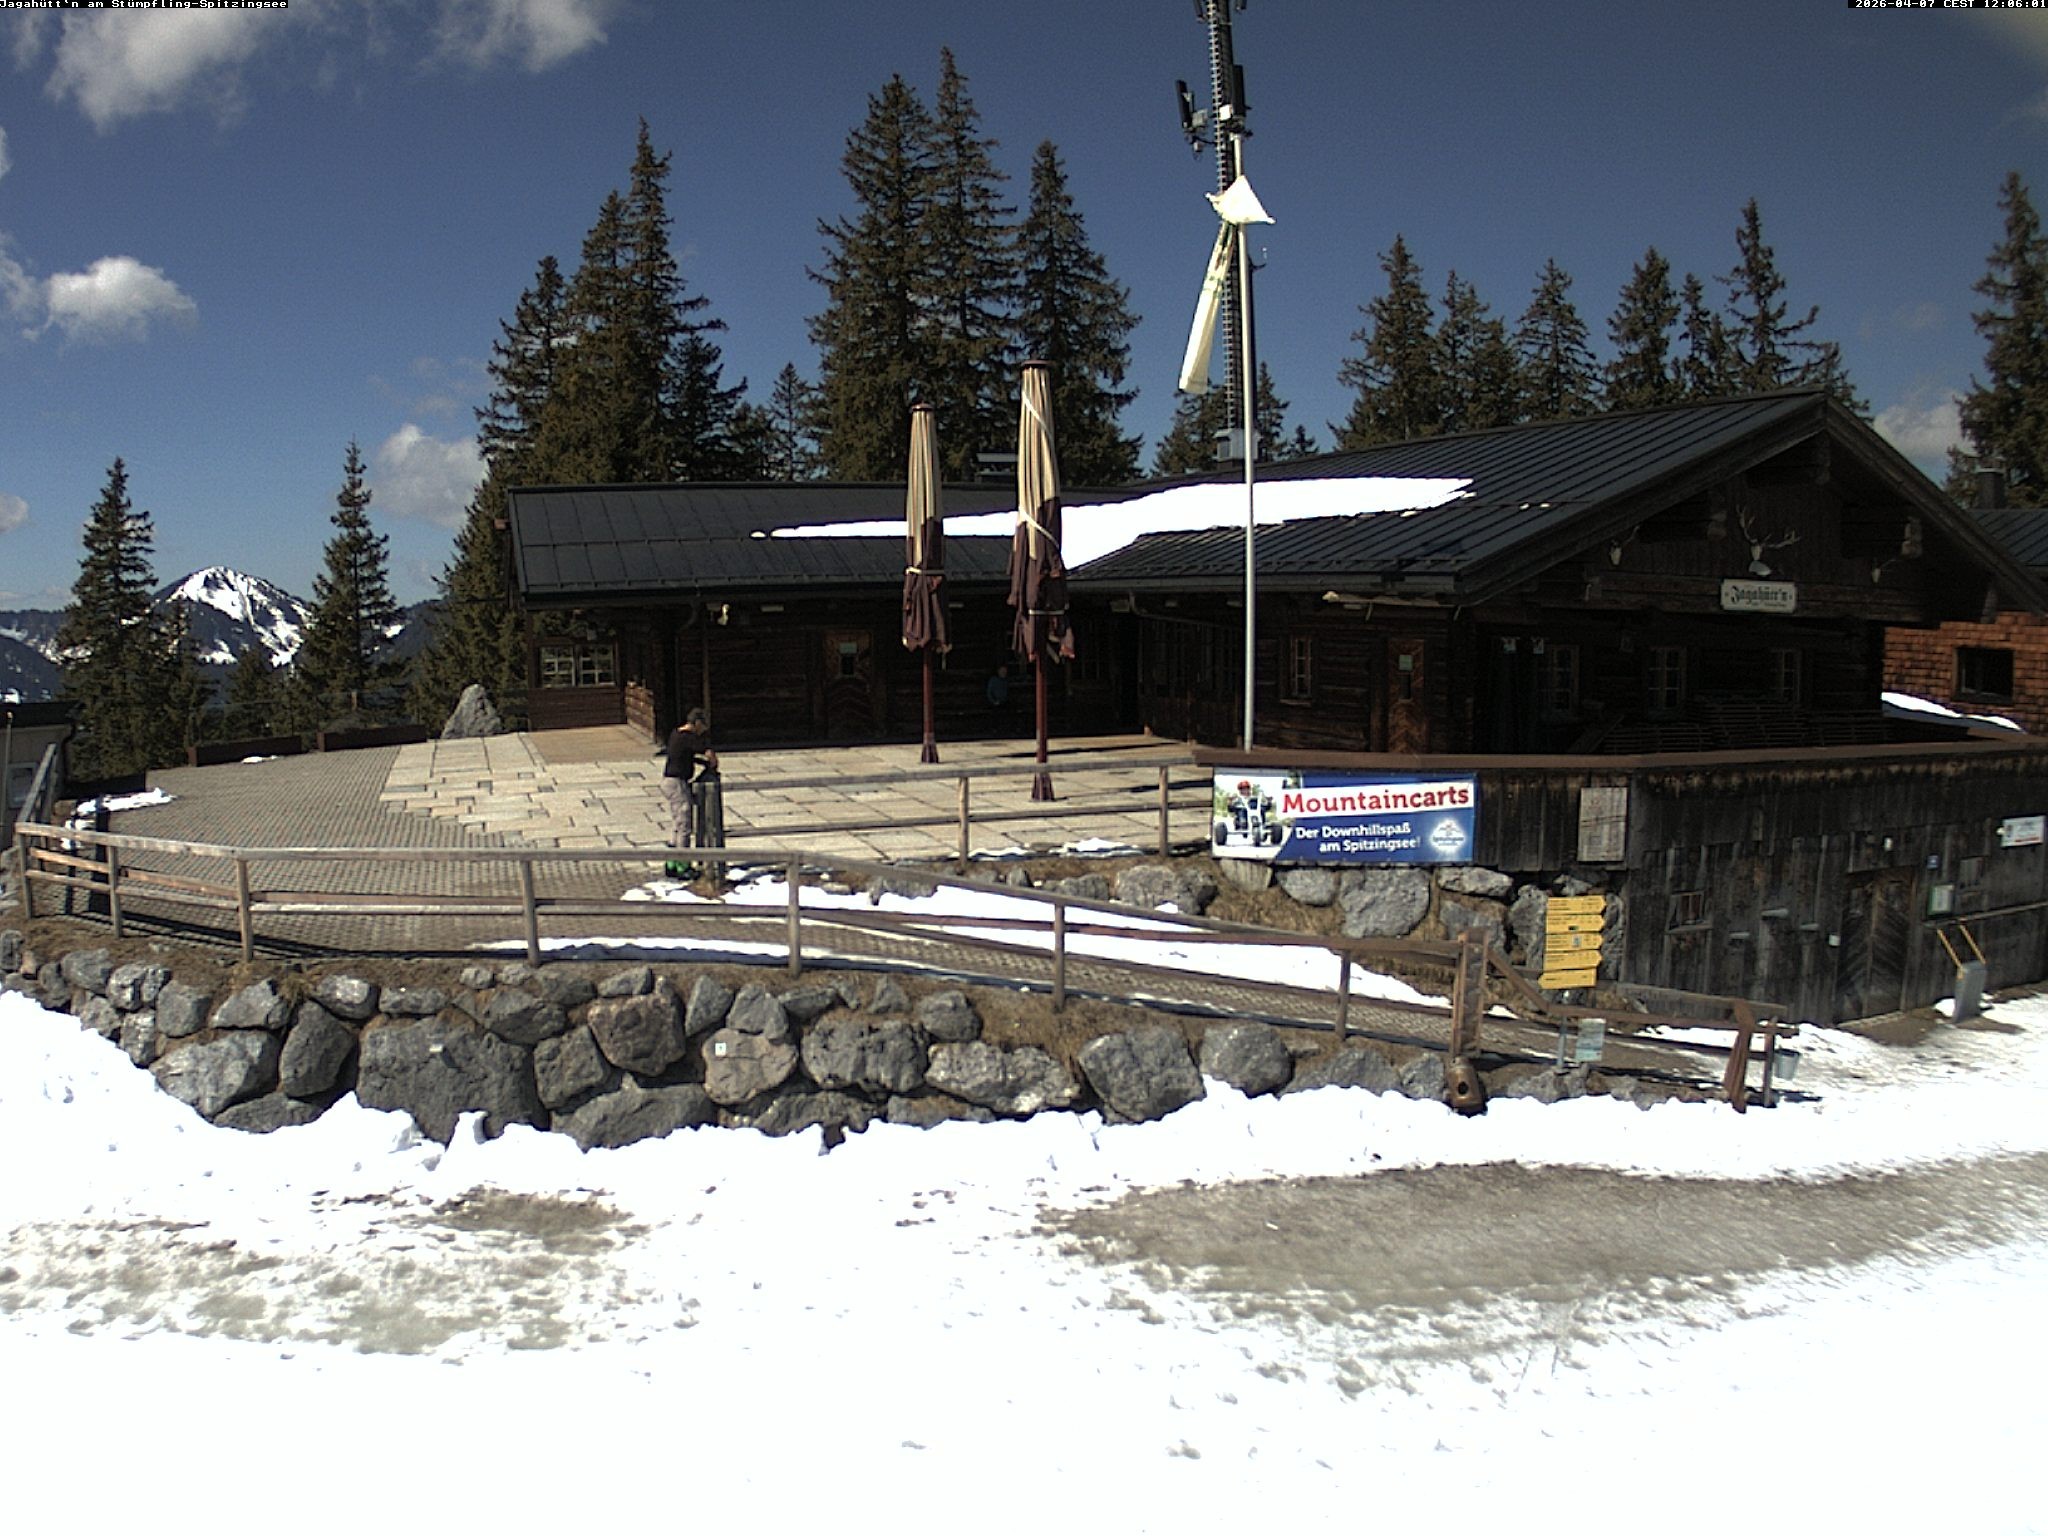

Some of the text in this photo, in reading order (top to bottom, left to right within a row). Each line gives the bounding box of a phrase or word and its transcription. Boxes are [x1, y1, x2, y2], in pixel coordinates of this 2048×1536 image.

[1282, 786, 1470, 813] Mountaincarts
[1295, 822, 1411, 840] Der Downhillspaß
[1318, 840, 1341, 853] am
